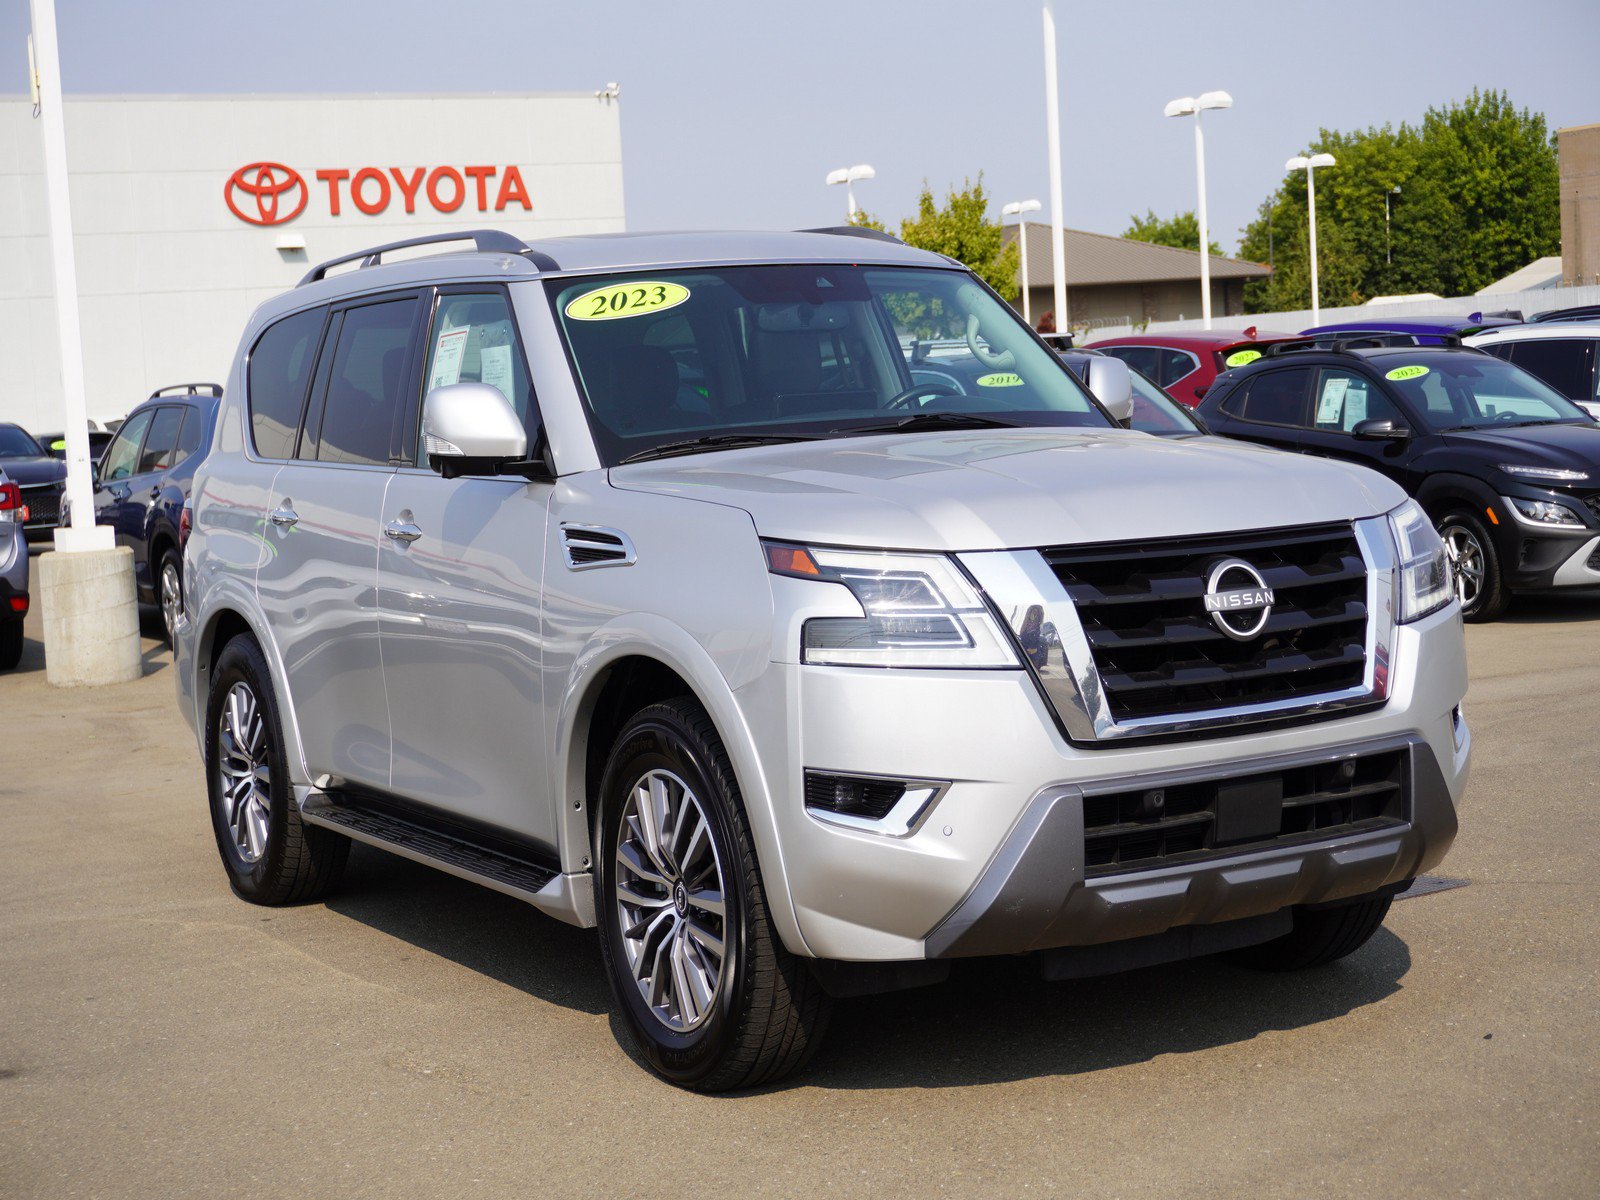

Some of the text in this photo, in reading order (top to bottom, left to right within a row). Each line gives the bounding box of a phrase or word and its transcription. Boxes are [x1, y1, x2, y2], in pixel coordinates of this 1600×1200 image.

[316, 165, 533, 216] TOYOTA
[590, 286, 666, 316] 2023
[1393, 367, 1421, 379] 2022
[1207, 591, 1274, 609] NISSAN
